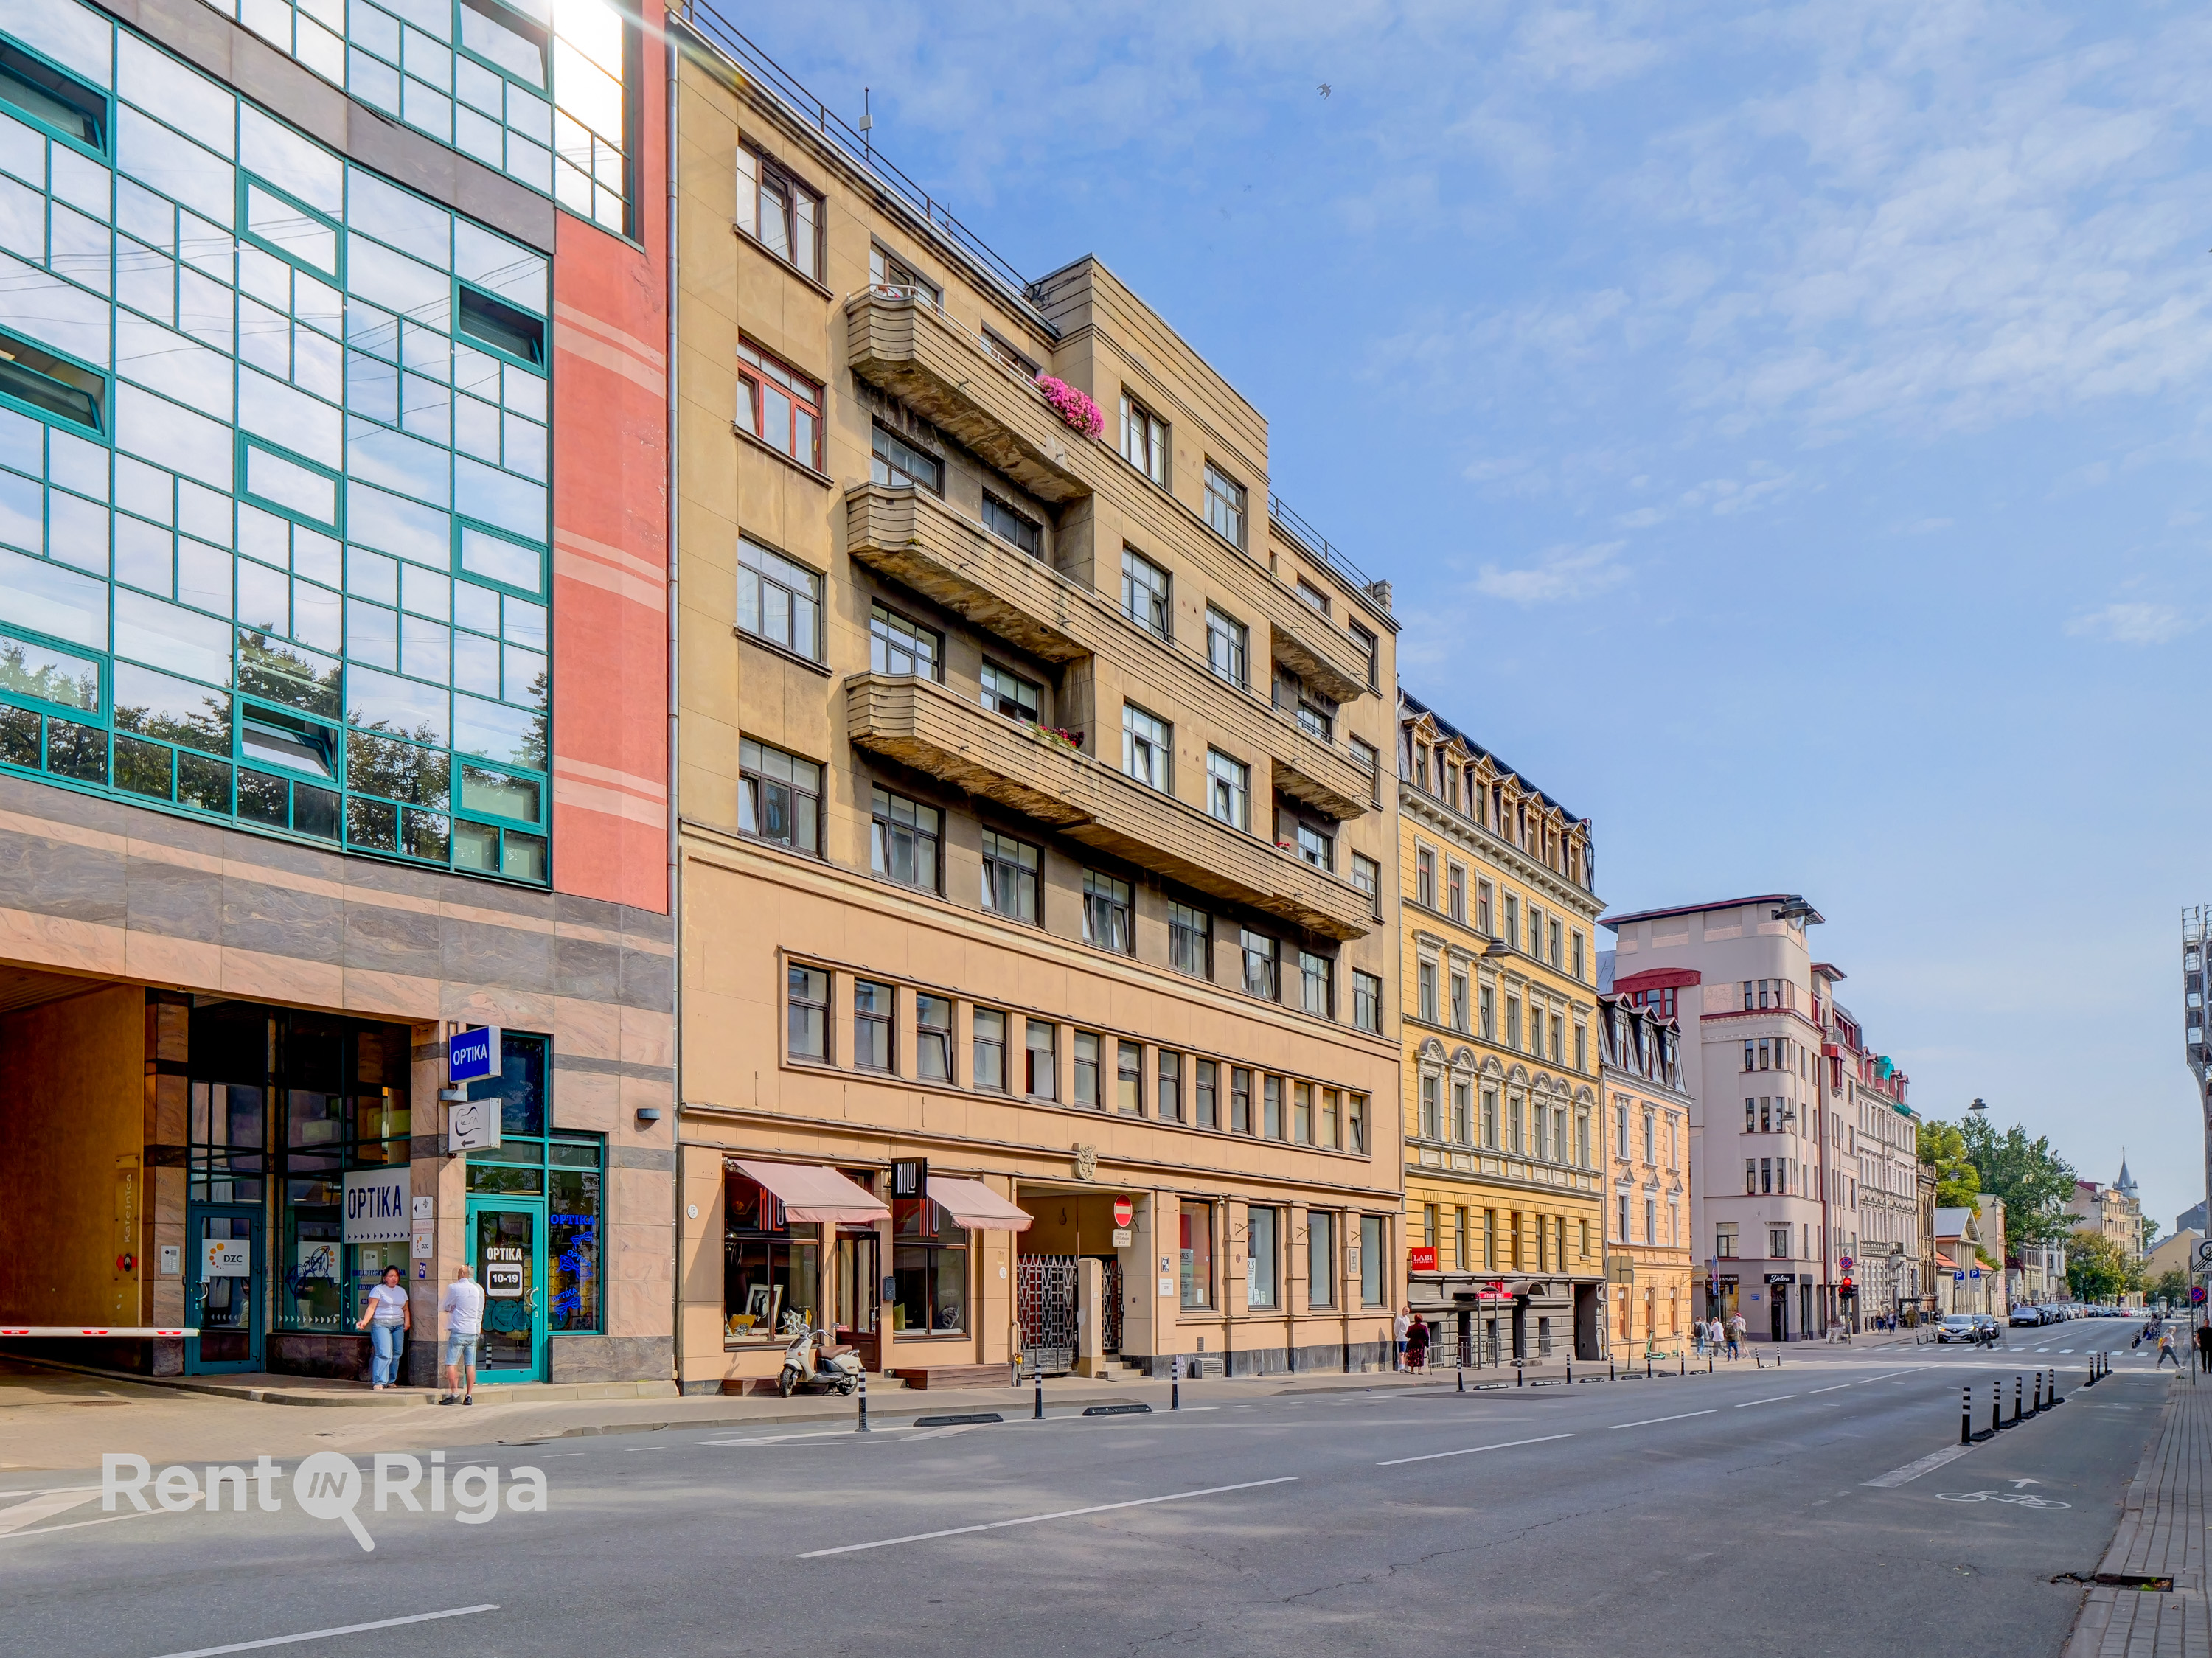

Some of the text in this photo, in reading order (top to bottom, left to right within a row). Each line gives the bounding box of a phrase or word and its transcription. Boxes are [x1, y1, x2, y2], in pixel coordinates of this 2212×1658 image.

[453, 1043, 488, 1066] OPTIKA
[897, 1163, 916, 1194] MILU
[348, 1185, 403, 1219] OPTIKA
[759, 1188, 784, 1232] MILU
[550, 1214, 596, 1225] OPTIKA
[919, 1198, 939, 1238] MILU
[223, 1255, 243, 1263] DZC
[487, 1247, 523, 1261] OPTIKA
[567, 1249, 592, 1267] OPTIKA
[492, 1273, 519, 1283] 10-19
[551, 1287, 578, 1303] OPTIKA
